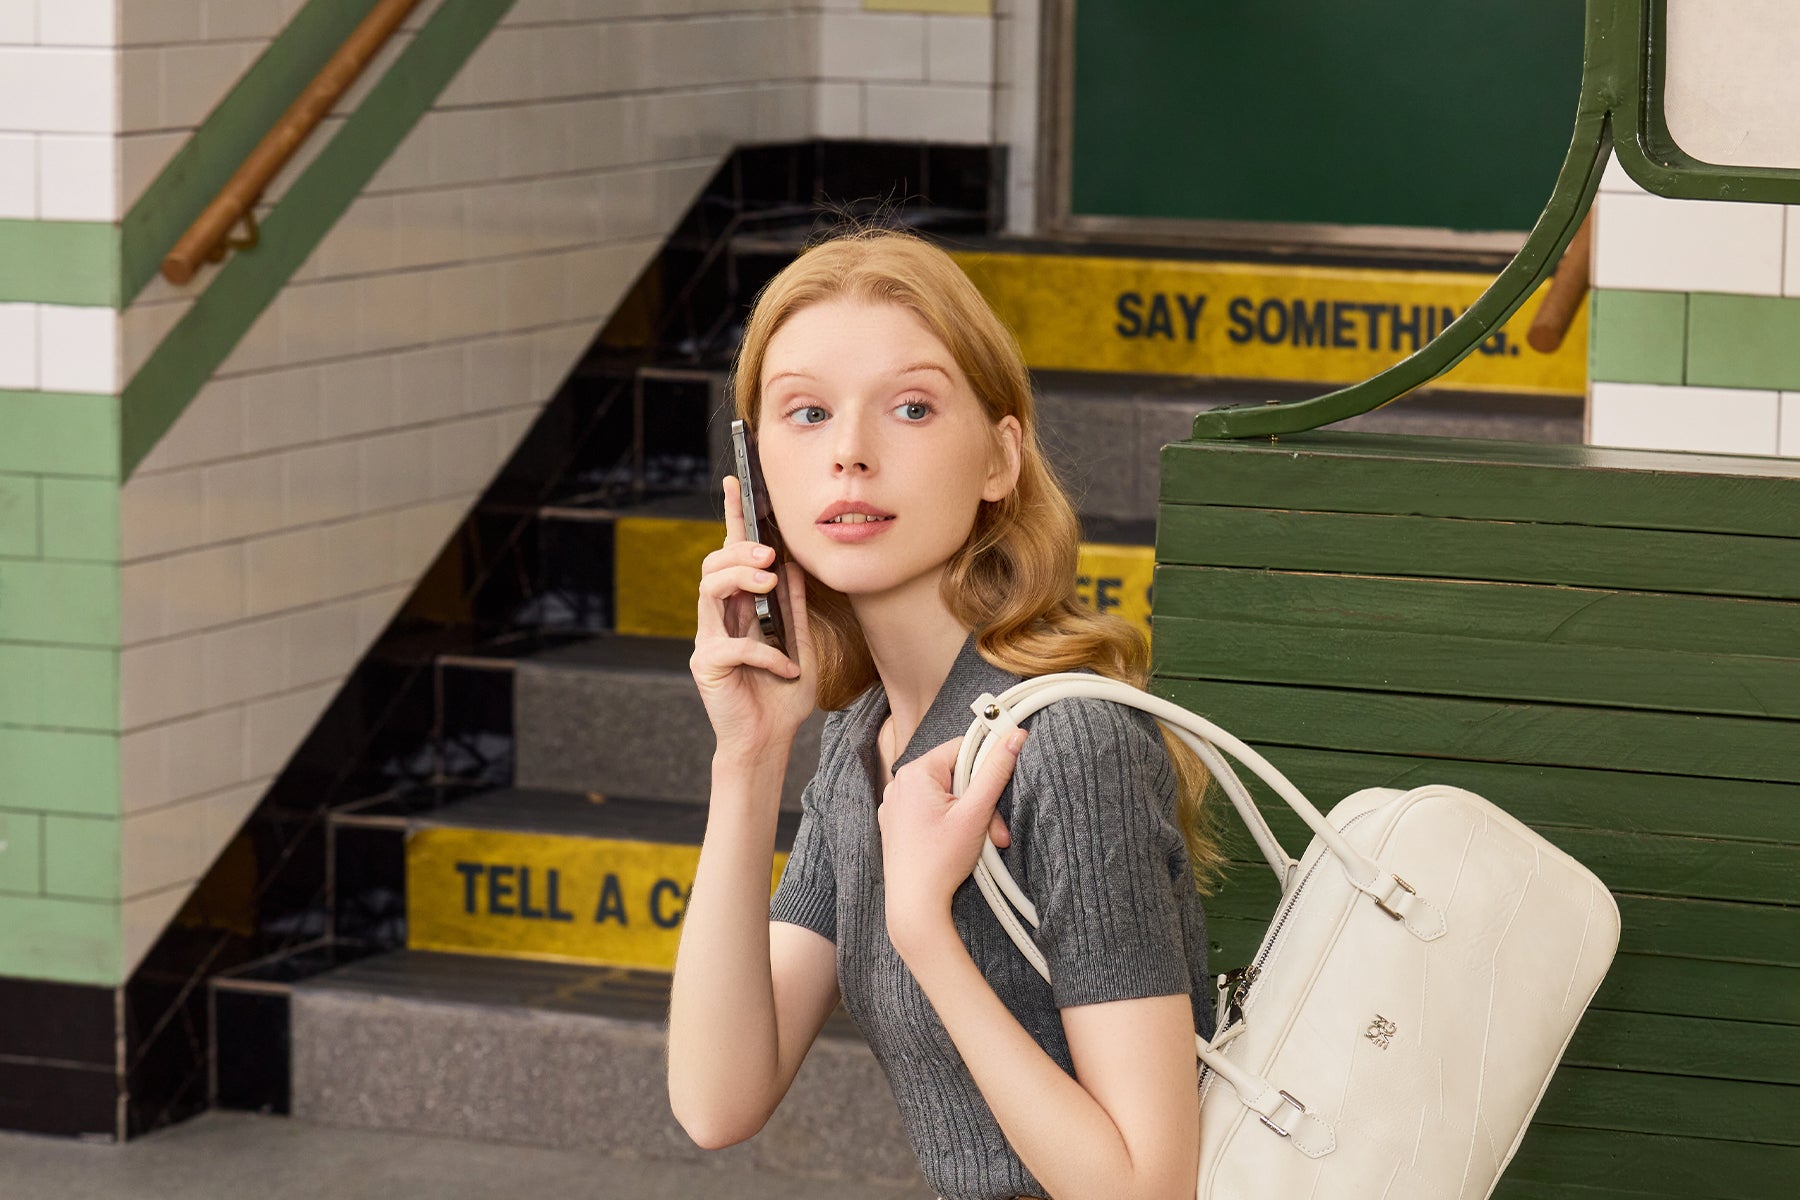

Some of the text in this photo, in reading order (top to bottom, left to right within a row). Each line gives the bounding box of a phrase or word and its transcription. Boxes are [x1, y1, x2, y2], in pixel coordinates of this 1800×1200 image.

[1115, 292, 1520, 357] SAY SOMETHI.
[455, 862, 692, 929] TELL A C
